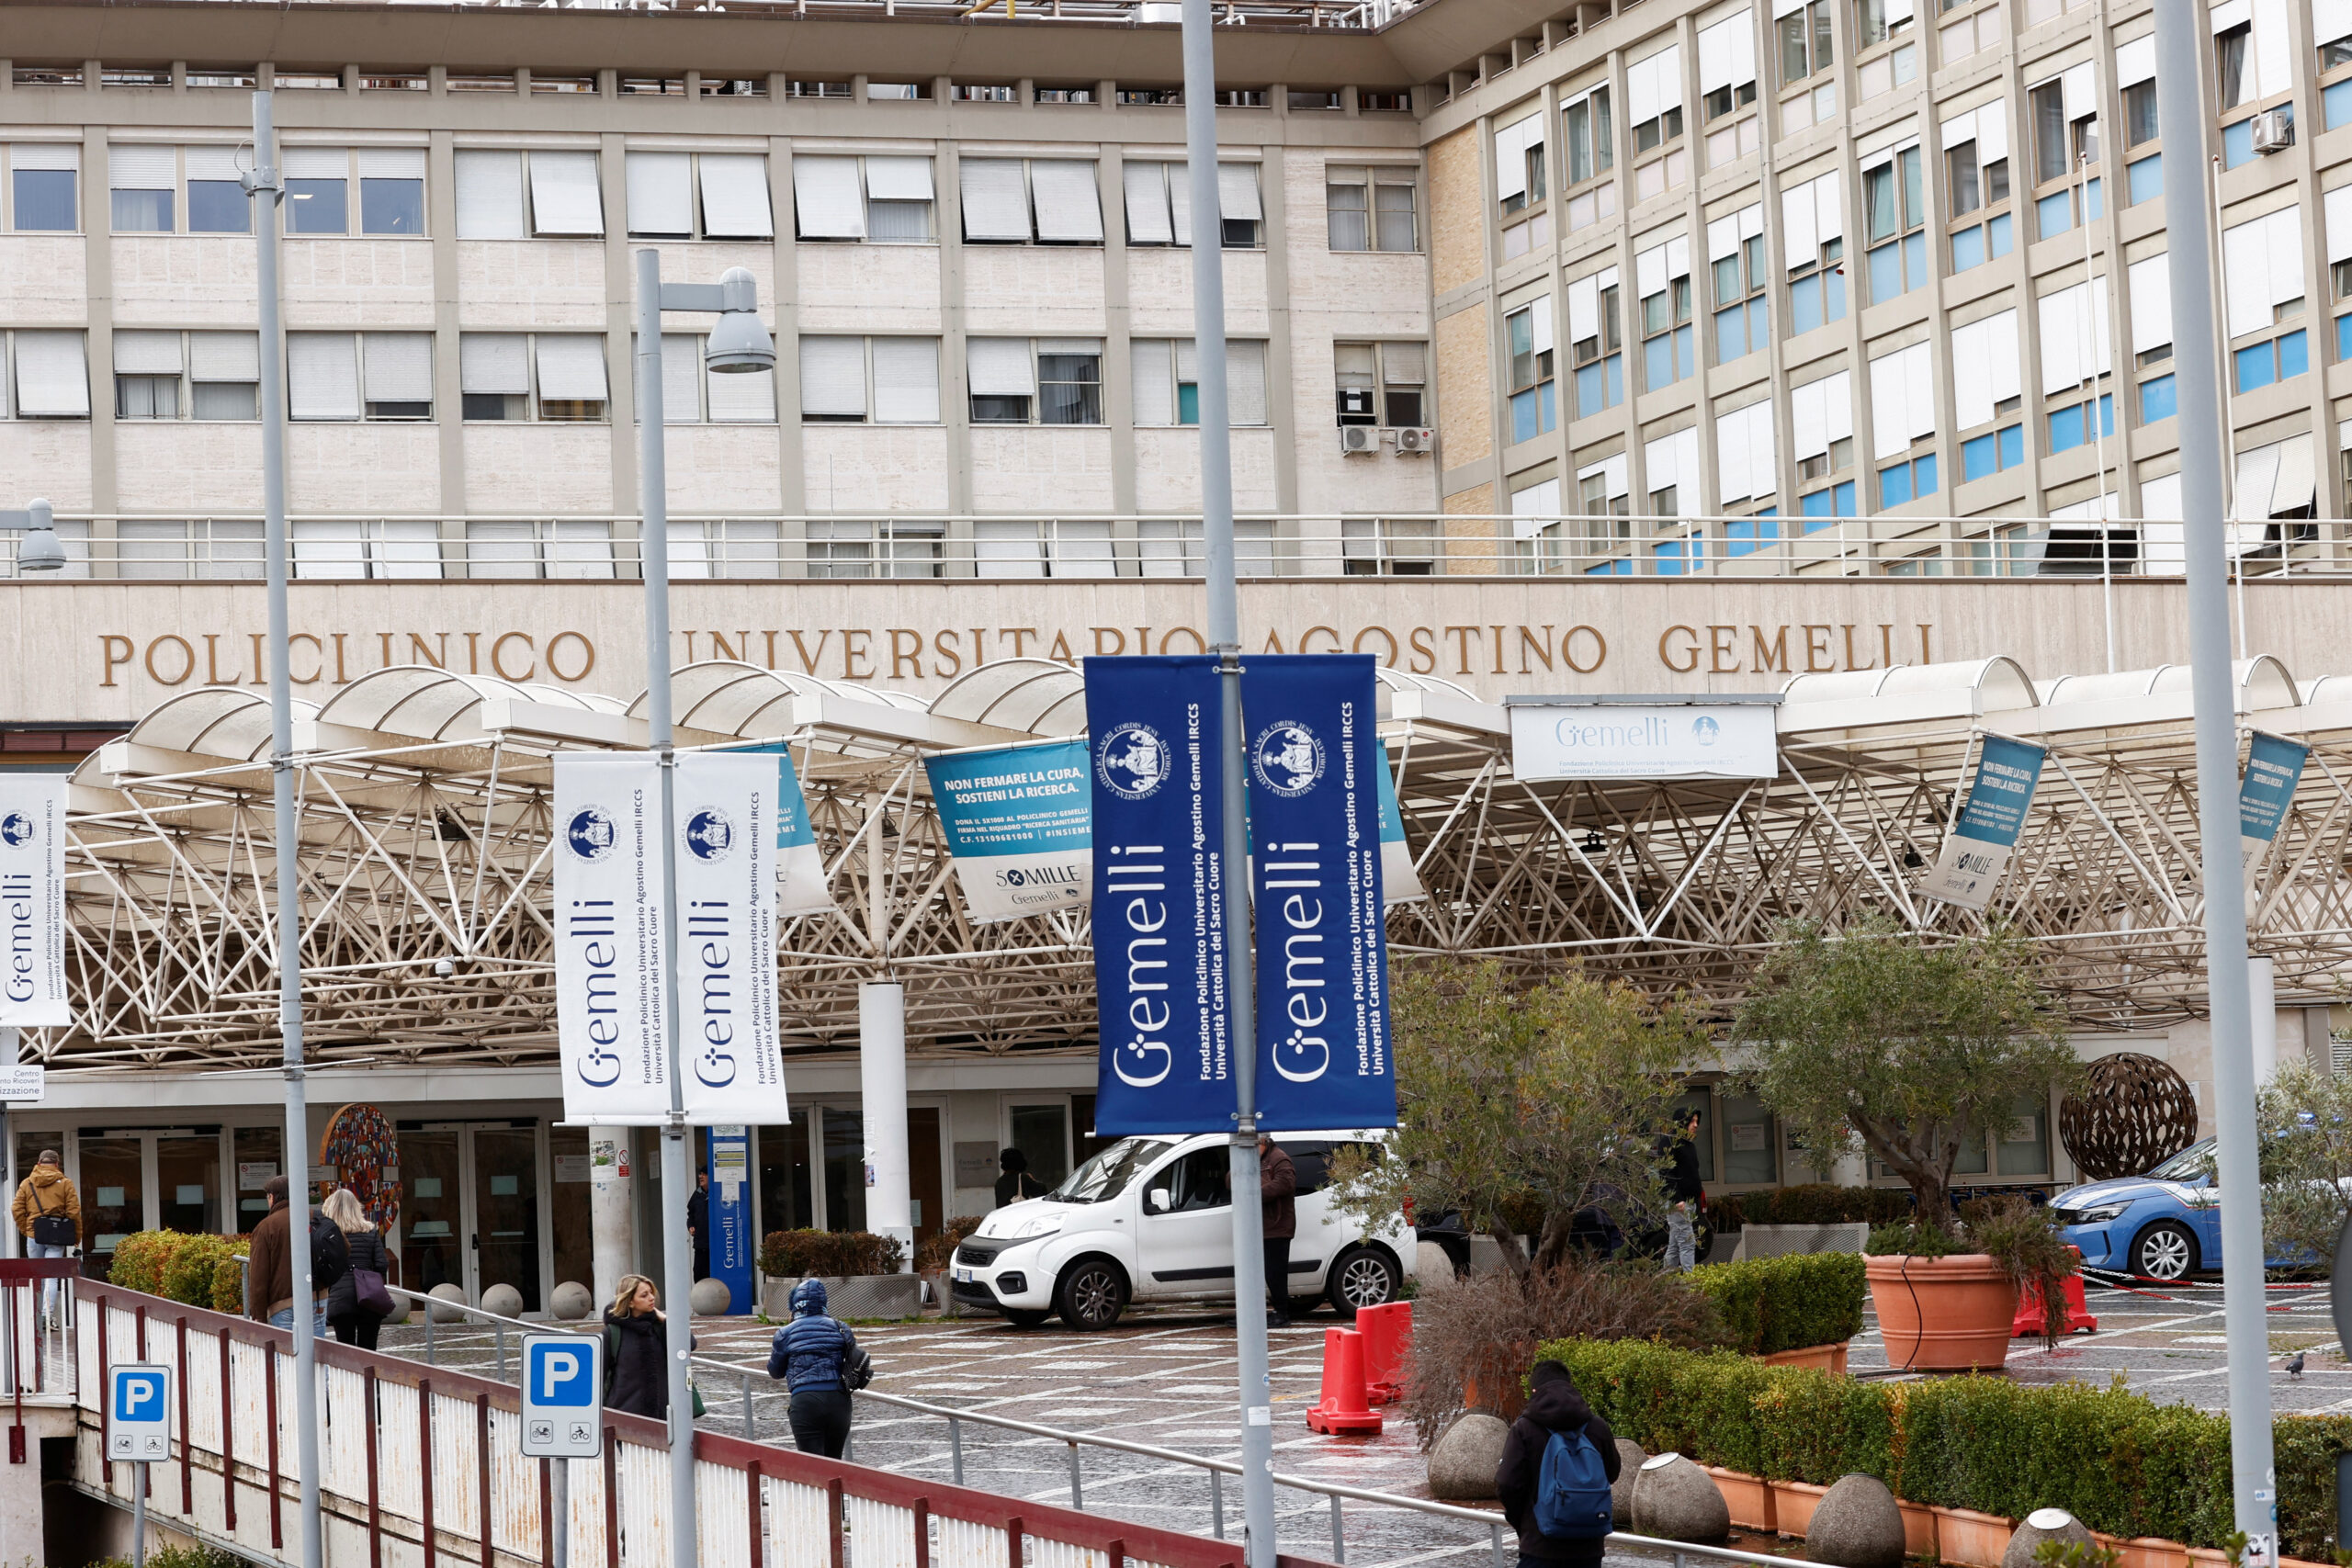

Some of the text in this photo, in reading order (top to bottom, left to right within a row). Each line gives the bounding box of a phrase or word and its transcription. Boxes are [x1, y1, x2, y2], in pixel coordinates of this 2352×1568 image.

[98, 631, 595, 687] POLICLINICO
[1659, 624, 1933, 674] GEMELLI
[1555, 716, 1668, 747] Gemelli
[944, 768, 1084, 791] NON FERMARE LA CURA,
[956, 783, 1080, 804] SOSTIENI LA RICERCA.
[989, 824, 1021, 832] RIQUADRO
[1017, 812, 1057, 820] POLICLINICO
[1059, 808, 1088, 817] GEMELLI
[1046, 827, 1091, 837] #INSIEME
[1011, 890, 1059, 905] Gemelli
[1188, 704, 1211, 1080] Fondazione Policlinico Universitario Agostino Gemelli IRCCS
[1342, 702, 1369, 1076] Fondazione Policlinico Universitario Agostino Gemelli IRCCS
[2, 874, 35, 1002] Gemelli
[634, 789, 651, 1084] Fondazione Policlinico Universitario Agostino Gemelli IRCCS
[750, 792, 765, 1084] Fondazione Policlinico Universitario Agostino Gemelli IRCCS
[761, 941, 769, 968] Sacro
[54, 965, 62, 999] Università
[761, 970, 770, 986] del
[1107, 845, 1171, 1087] Gemelli
[1208, 852, 1227, 1079] Università Cattolica del Sacro Cuore
[1265, 842, 1329, 1083] Gemelli
[1363, 851, 1384, 1075] Università Cattolica del Sacro Cuore
[571, 900, 621, 1089] Gemelli
[649, 906, 663, 1084] Università Cattolica del Sacro Cuore
[688, 901, 736, 1089] Gemelli
[763, 988, 772, 1032] Cattolica
[764, 1034, 777, 1084] Università
[722, 1217, 734, 1269] Gemelli
[125, 1378, 154, 1416] P
[544, 1352, 580, 1398] P
